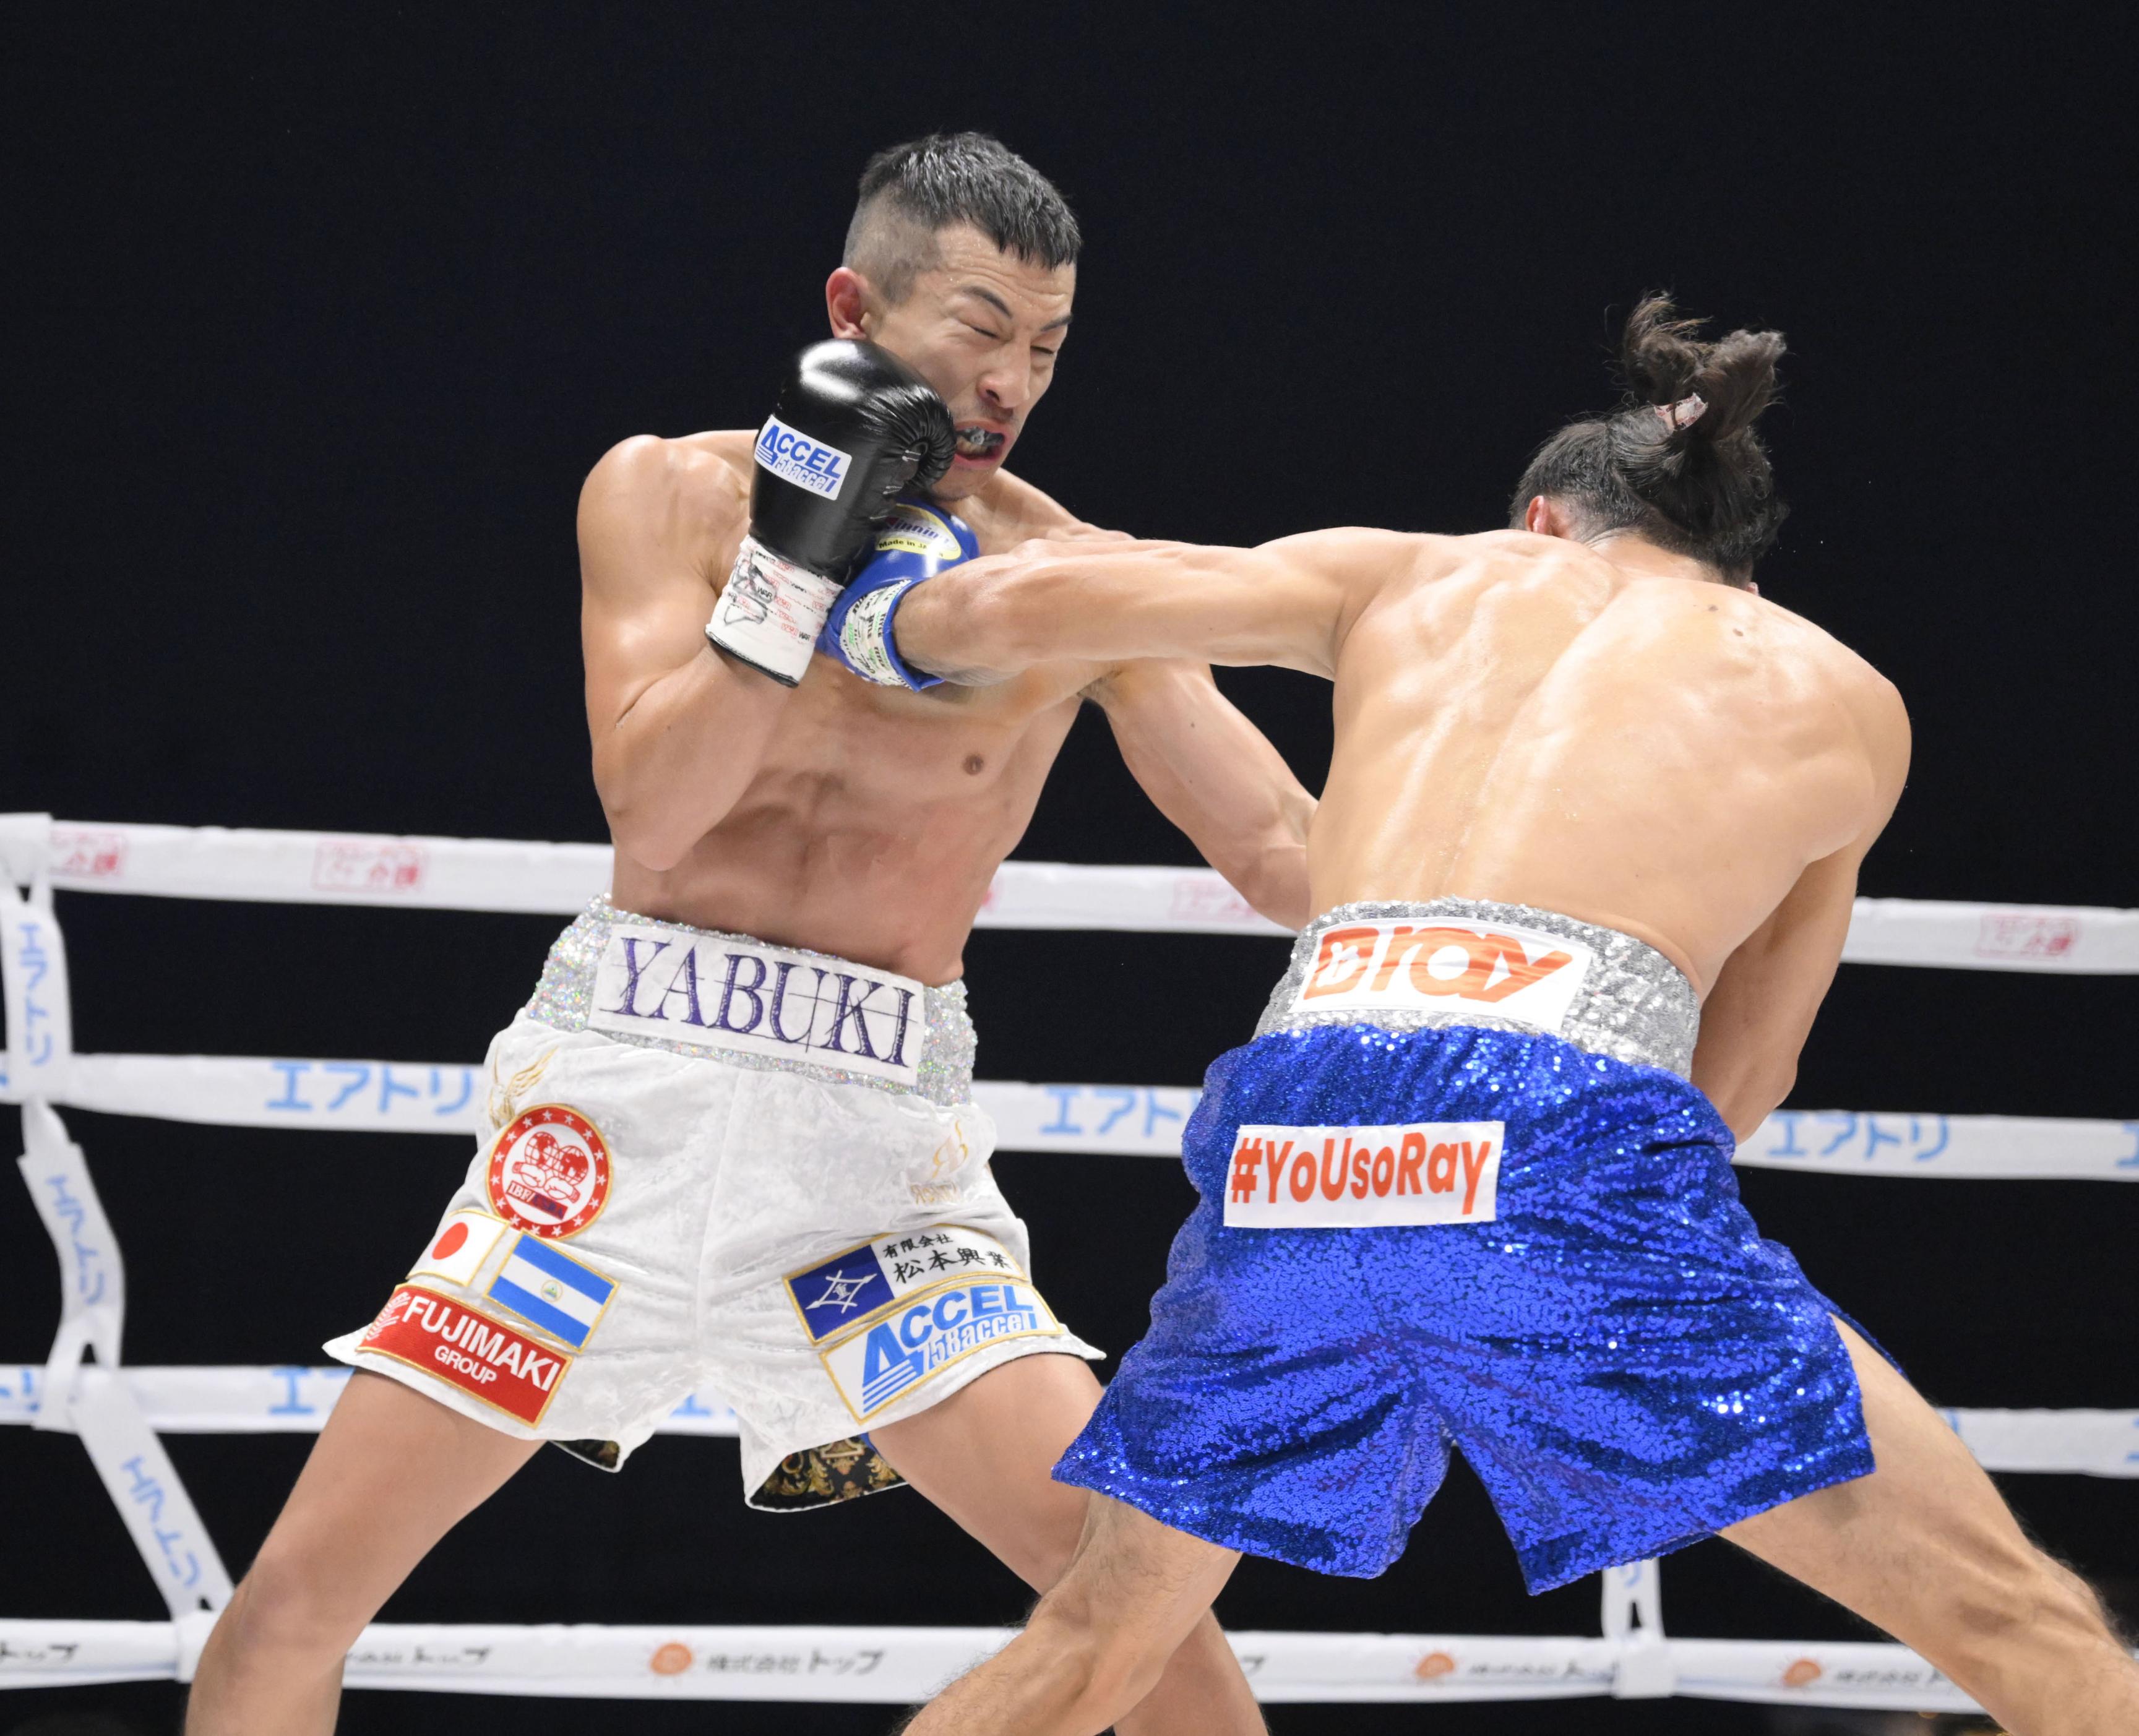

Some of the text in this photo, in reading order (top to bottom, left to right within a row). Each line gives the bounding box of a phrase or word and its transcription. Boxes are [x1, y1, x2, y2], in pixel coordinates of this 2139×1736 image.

[760, 424, 841, 479] ACCEL
[879, 539, 904, 549] Made
[603, 937, 916, 1068] YABUKI
[265, 1060, 474, 1115] エアトリ
[1039, 1085, 1199, 1138] エアト
[1767, 1111, 1950, 1162] エアトリ
[1231, 1132, 1492, 1216] #YoUsoRay
[882, 1234, 953, 1258] 有限会社
[402, 1295, 561, 1392] FUJIMAKI
[862, 1285, 1034, 1389] ACCEL
[434, 1345, 497, 1385] GROUP
